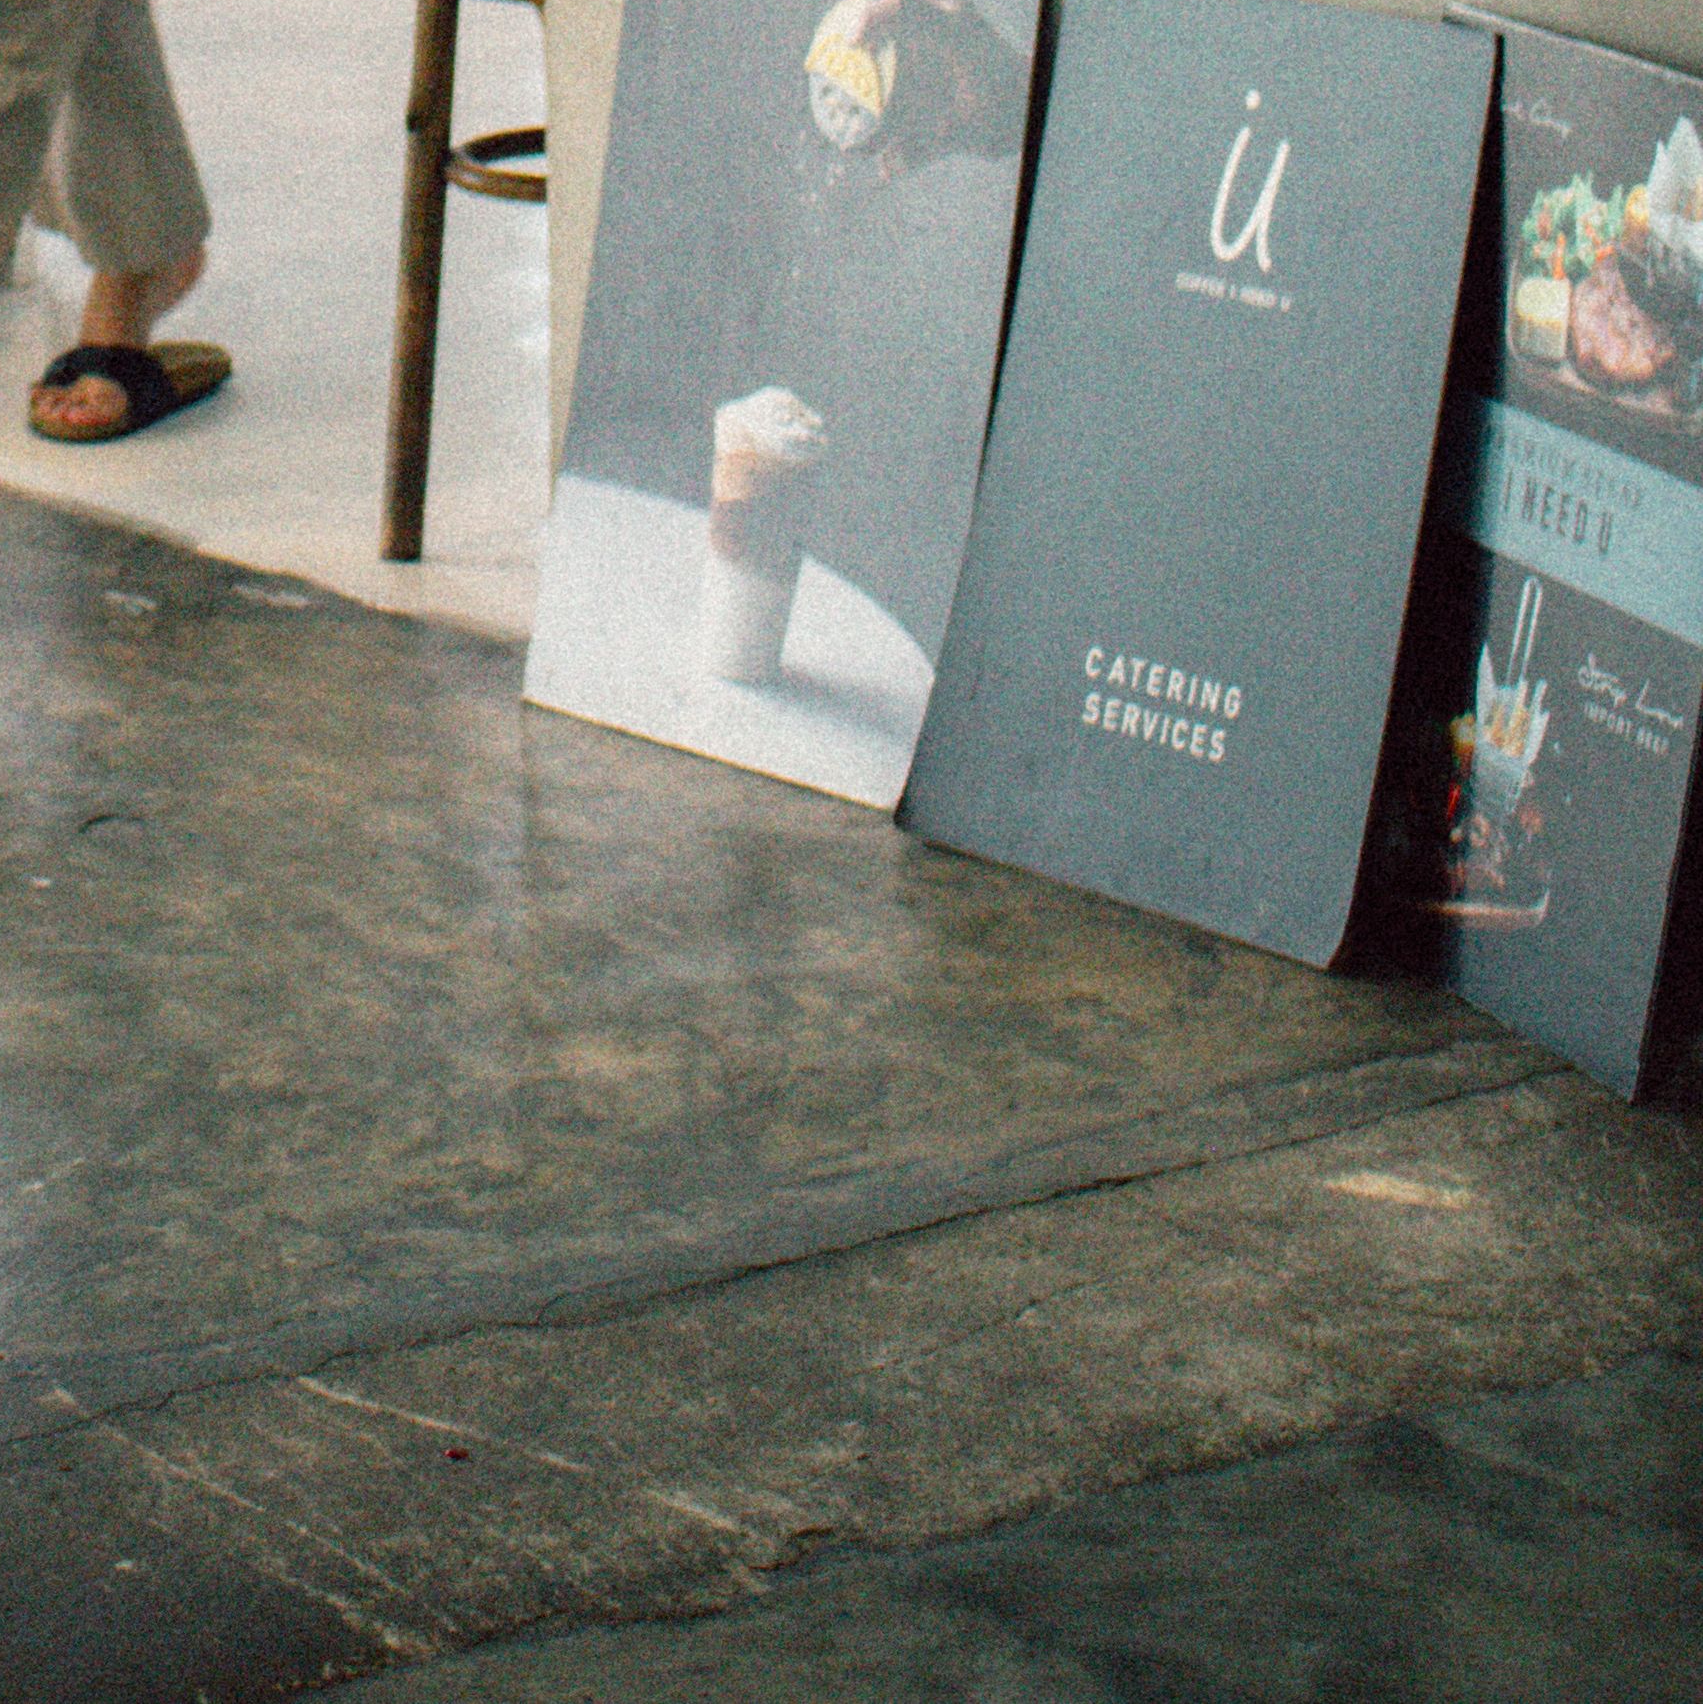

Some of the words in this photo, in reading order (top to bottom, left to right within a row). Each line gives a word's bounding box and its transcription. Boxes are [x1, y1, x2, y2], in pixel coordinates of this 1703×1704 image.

[1521, 475, 1589, 543] NEED
[1598, 508, 1614, 553] U
[1085, 645, 1242, 720] CATERING
[1081, 692, 1226, 764] SERVICES
